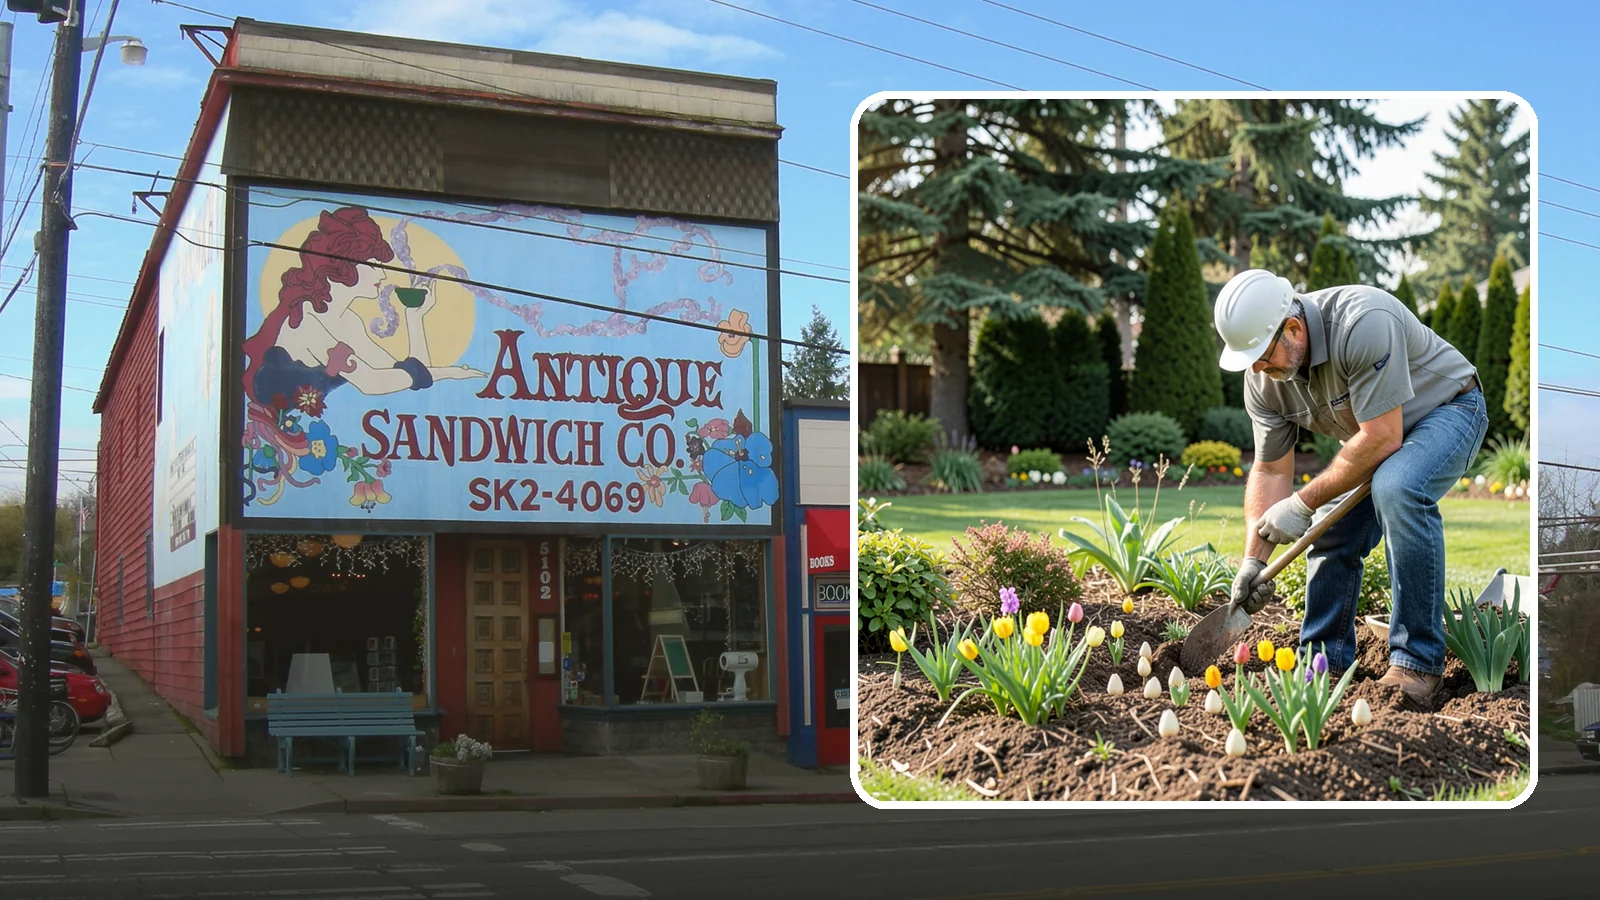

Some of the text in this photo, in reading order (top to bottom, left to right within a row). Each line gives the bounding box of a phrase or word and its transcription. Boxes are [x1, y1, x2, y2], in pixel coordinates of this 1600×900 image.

[476, 329, 723, 420] ANTIQUE
[361, 408, 685, 469] SANDWICH CO.
[468, 477, 645, 513] SK2-4069
[540, 541, 551, 600] 5102
[809, 555, 835, 569] BOOKS
